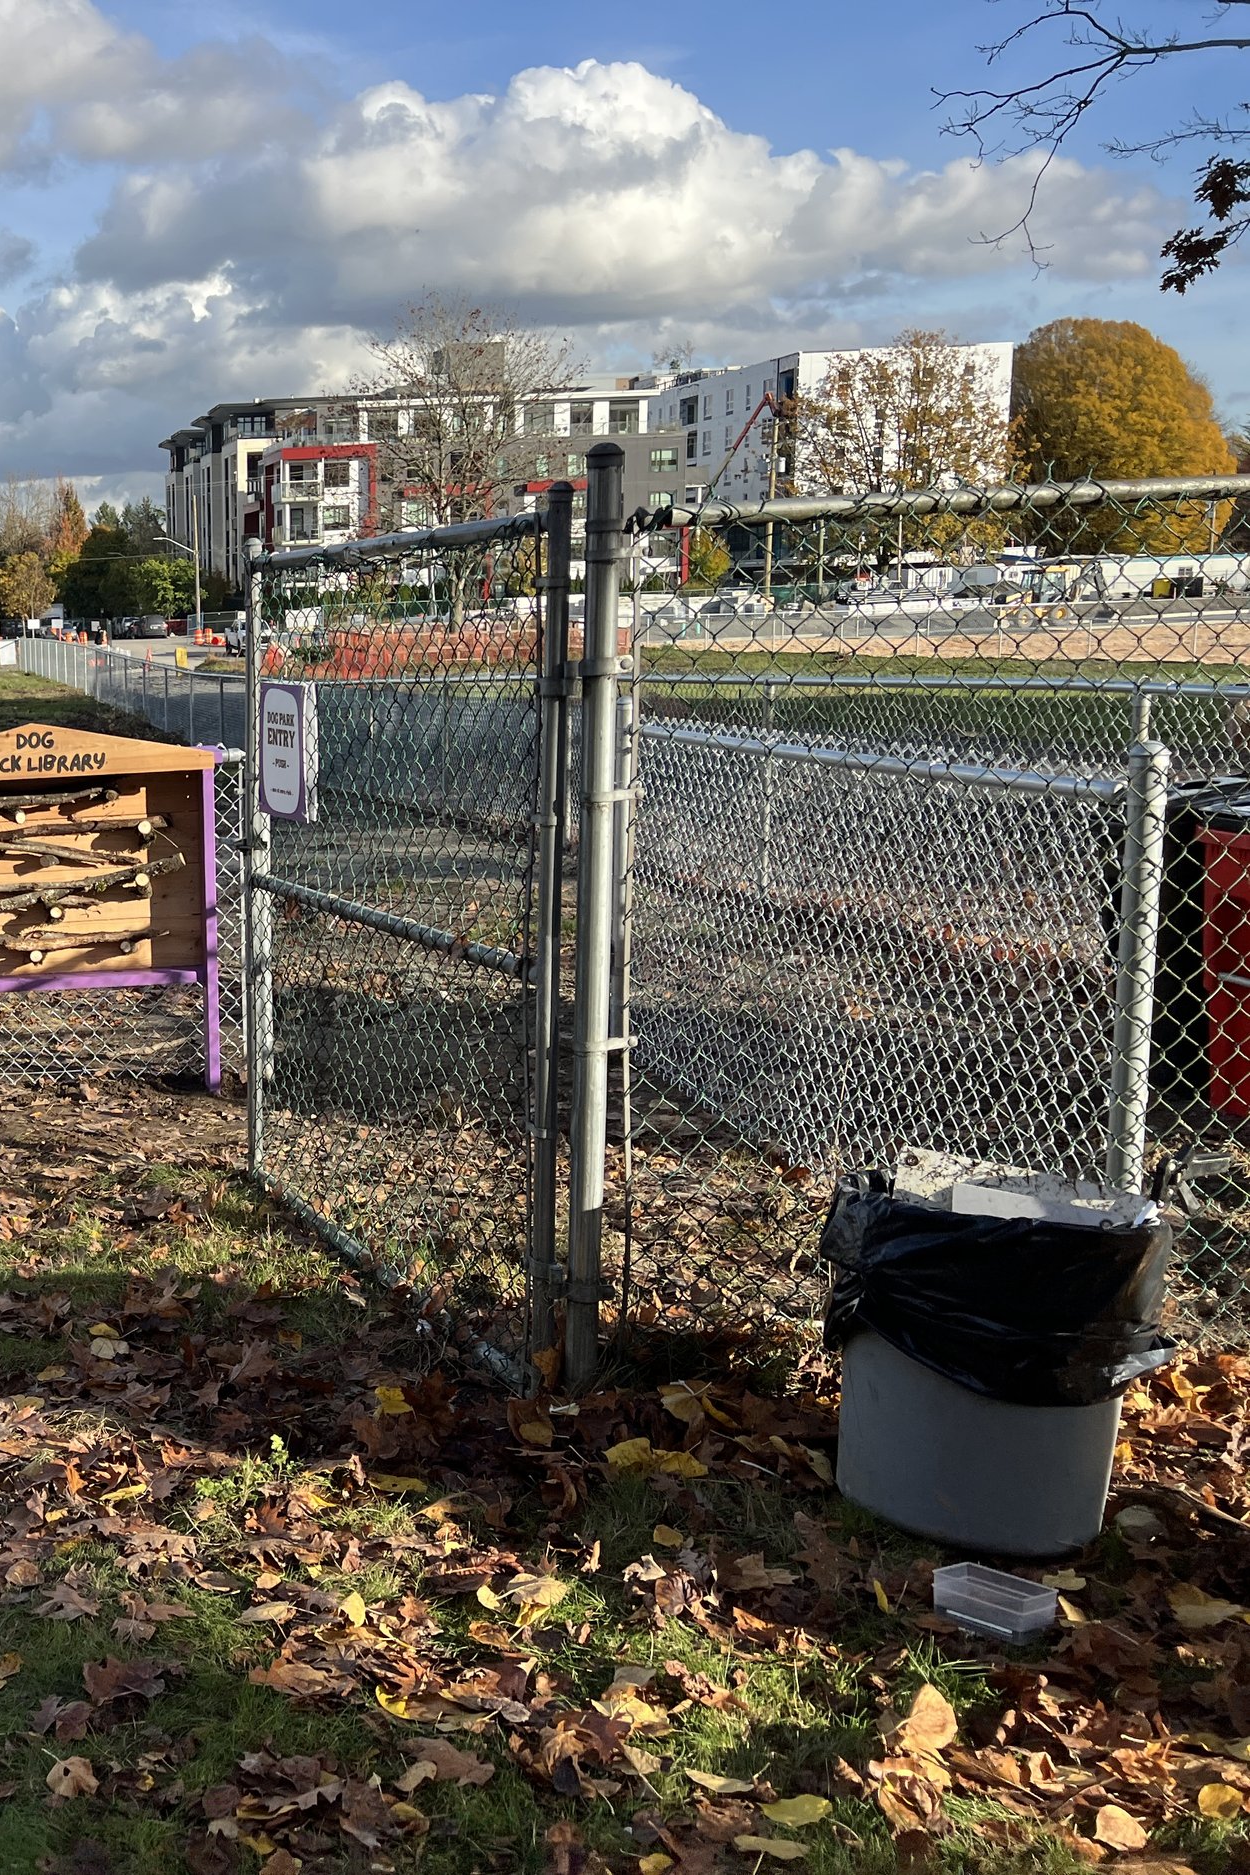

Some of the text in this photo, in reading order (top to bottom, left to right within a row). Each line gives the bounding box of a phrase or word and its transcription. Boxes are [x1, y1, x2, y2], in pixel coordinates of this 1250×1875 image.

[267, 712, 295, 726] DOG PARK
[16, 731, 54, 750] DOG
[268, 728, 295, 748] ENTRY
[27, 752, 106, 774] LIBRARY
